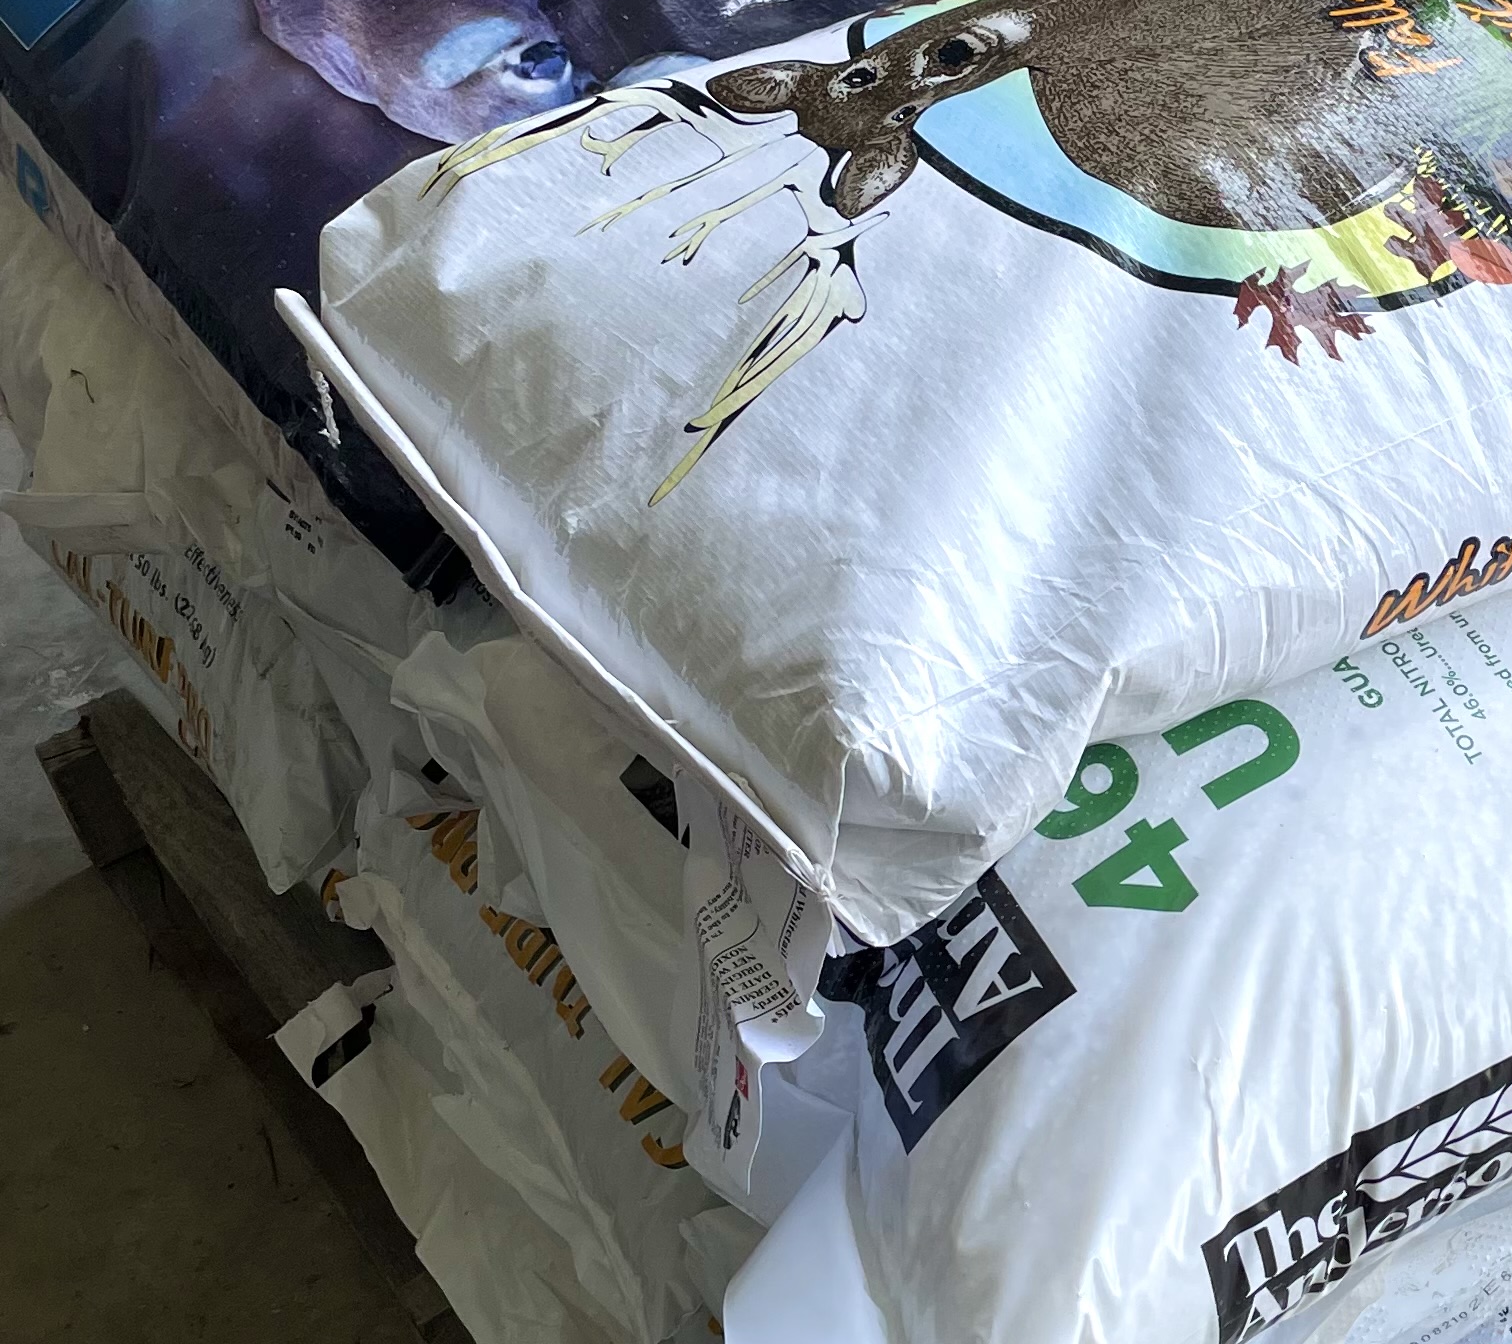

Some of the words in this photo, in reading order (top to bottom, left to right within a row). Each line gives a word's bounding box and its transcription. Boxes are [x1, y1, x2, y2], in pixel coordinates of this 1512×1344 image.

[1449, 610, 1470, 629] ur
[1466, 629, 1503, 668] from
[1331, 654, 1384, 710] GUA
[1381, 640, 1436, 698] NITRO
[1431, 697, 1483, 766] TOTAL
[1032, 741, 1201, 914] 46
[707, 943, 749, 973] NOXIO
[731, 977, 780, 1007] GERMIN
[744, 968, 773, 991] DATE
[750, 986, 790, 1012] Hardy
[1221, 1188, 1352, 1288] The
